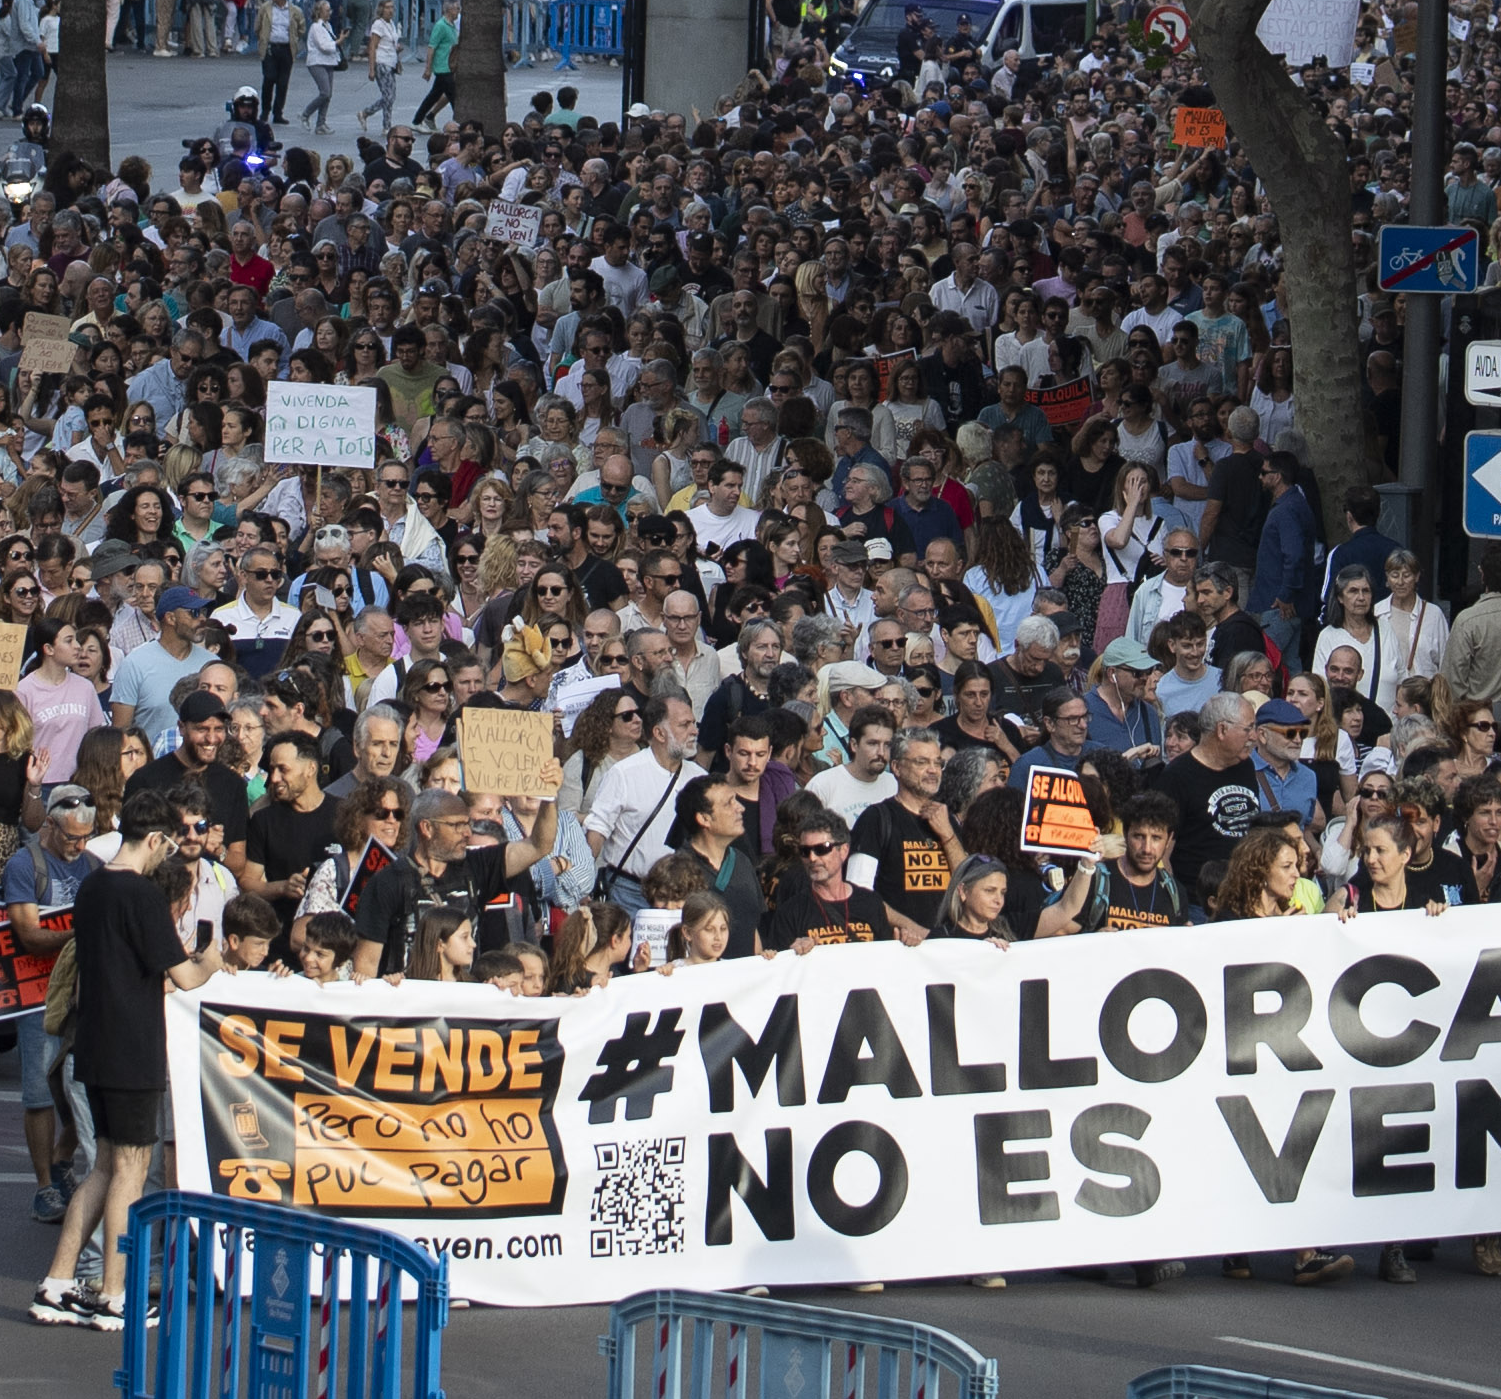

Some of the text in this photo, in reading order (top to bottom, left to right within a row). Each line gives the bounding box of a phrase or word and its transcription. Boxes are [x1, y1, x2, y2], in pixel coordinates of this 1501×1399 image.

[490, 203, 539, 221] MALLORCA
[491, 226, 505, 237] ES
[504, 218, 520, 229] NO
[1474, 355, 1499, 377] AVDA.
[281, 395, 350, 408] VIVENDA
[1041, 381, 1089, 403] ALQUILA
[297, 415, 357, 429] DIGNA
[272, 437, 304, 456] PER
[313, 438, 328, 457] A
[467, 724, 545, 752] MALLORCA
[469, 746, 541, 772] I VOLEM
[469, 769, 513, 789] VIURE
[1031, 774, 1050, 799] SE
[908, 853, 948, 867] NO E
[908, 874, 943, 887] VEN
[1108, 905, 1170, 925] MALLORCA
[218, 1014, 544, 1094] SE VENDE
[420, 1113, 467, 1144] no
[479, 1102, 534, 1146] ho
[306, 1152, 531, 1208] puc pagar
[704, 1119, 909, 1246] NO
[975, 1102, 1162, 1225] ES
